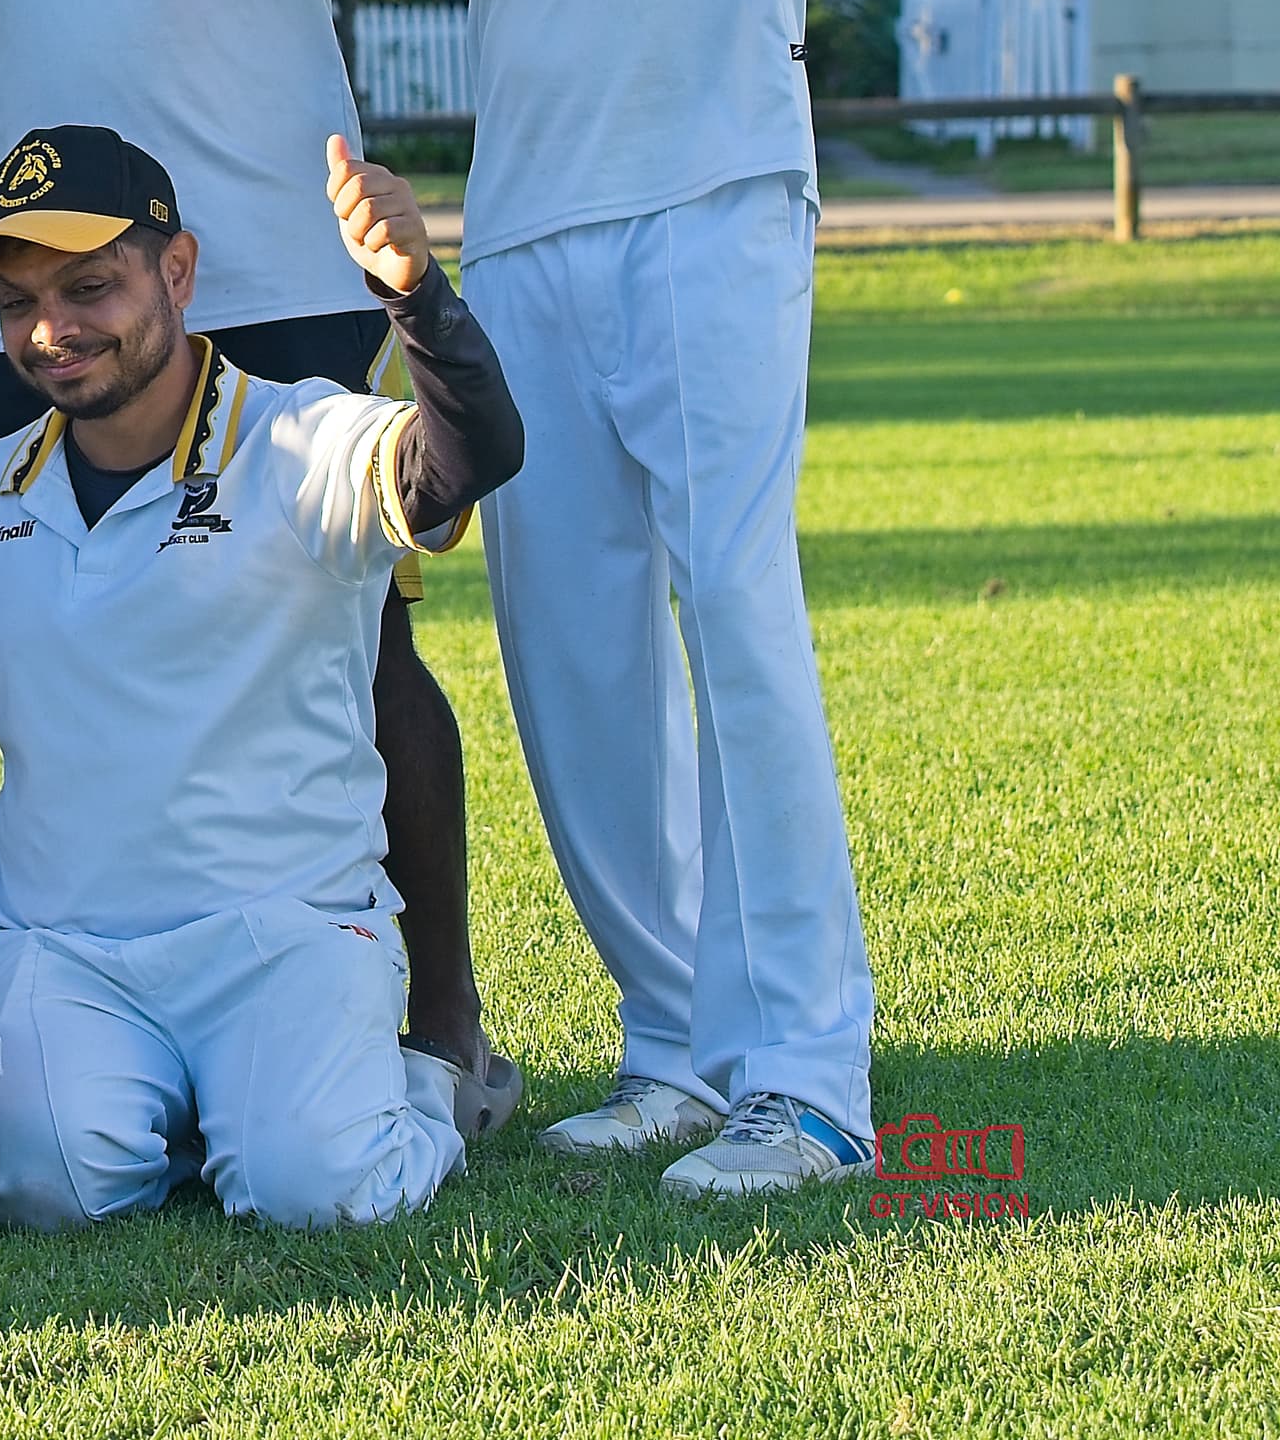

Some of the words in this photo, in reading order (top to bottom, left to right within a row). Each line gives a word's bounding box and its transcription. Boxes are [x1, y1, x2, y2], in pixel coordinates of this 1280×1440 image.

[40, 142, 63, 170] COLTS
[29, 180, 55, 201] CLUB
[188, 534, 210, 544] CLUB
